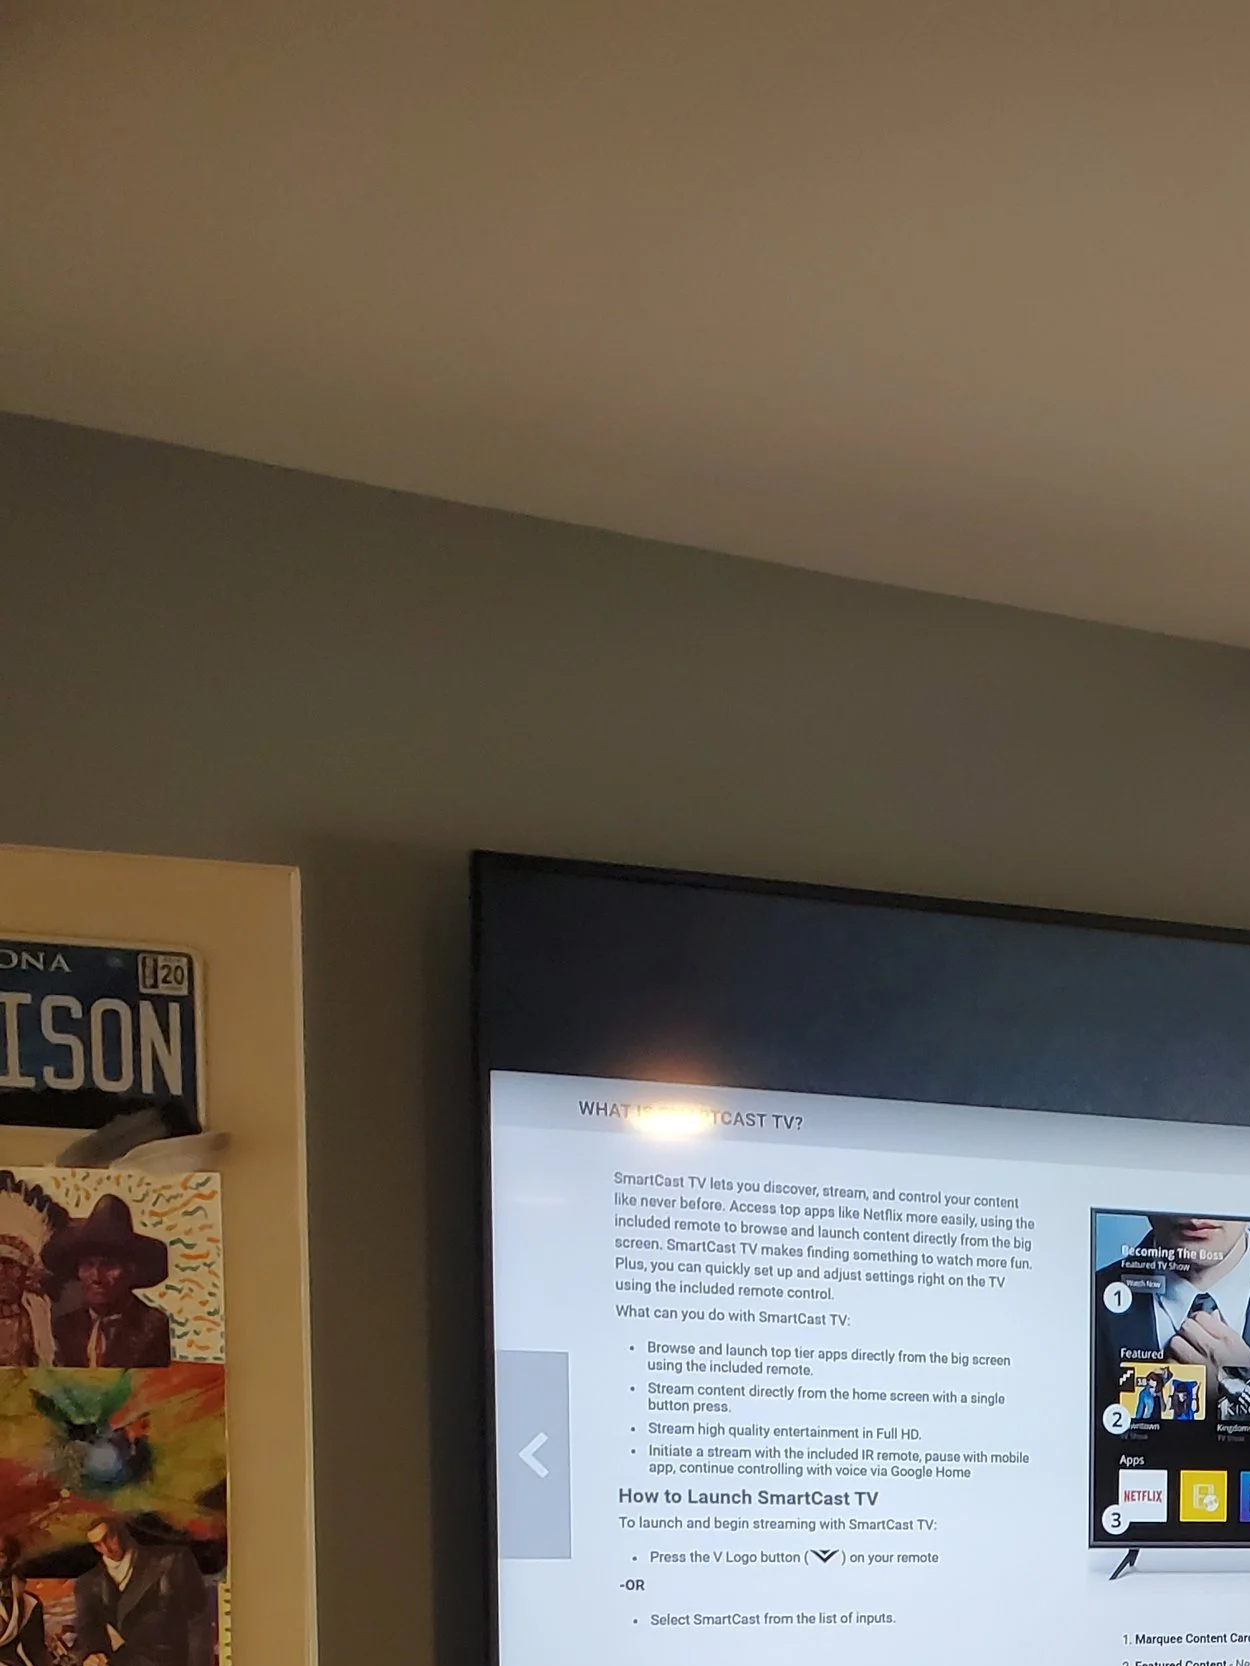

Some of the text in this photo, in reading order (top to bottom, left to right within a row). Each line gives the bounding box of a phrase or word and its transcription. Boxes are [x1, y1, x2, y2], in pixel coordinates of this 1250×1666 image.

[161, 964, 184, 985] 20
[0, 991, 183, 1097] ISON
[579, 1100, 629, 1118] WHAT
[772, 1113, 803, 1130] TV?
[613, 1171, 1019, 1209] SmartCast TV lets you discover, stream, and control your content
[1121, 1244, 1224, 1261] Becoming The Boss
[1121, 1260, 1190, 1271] Featured TV Show
[1113, 1290, 1122, 1307] 1
[615, 1304, 850, 1327] What can you do with SmartCast TV:
[1120, 1347, 1164, 1360] Featured
[1112, 1411, 1123, 1428] 2
[647, 1421, 922, 1441] Stream high quality entertainment in Full HD.
[1119, 1454, 1145, 1467] Apps
[618, 1488, 878, 1506] How to Launch SmartCast TV
[1124, 1490, 1162, 1503] NETFLIX
[618, 1515, 937, 1532] To launch and begin streaming with SmartCast TV:
[1111, 1512, 1121, 1528] 3
[650, 1549, 939, 1566] Press the V Logo button on your remote
[619, 1578, 645, 1591] -OR
[650, 1610, 896, 1626] Select SmartCast from the list of inputs.
[1123, 1633, 1132, 1645] 1.
[1135, 1633, 1183, 1647] Marquee
[1185, 1632, 1228, 1644] Content
